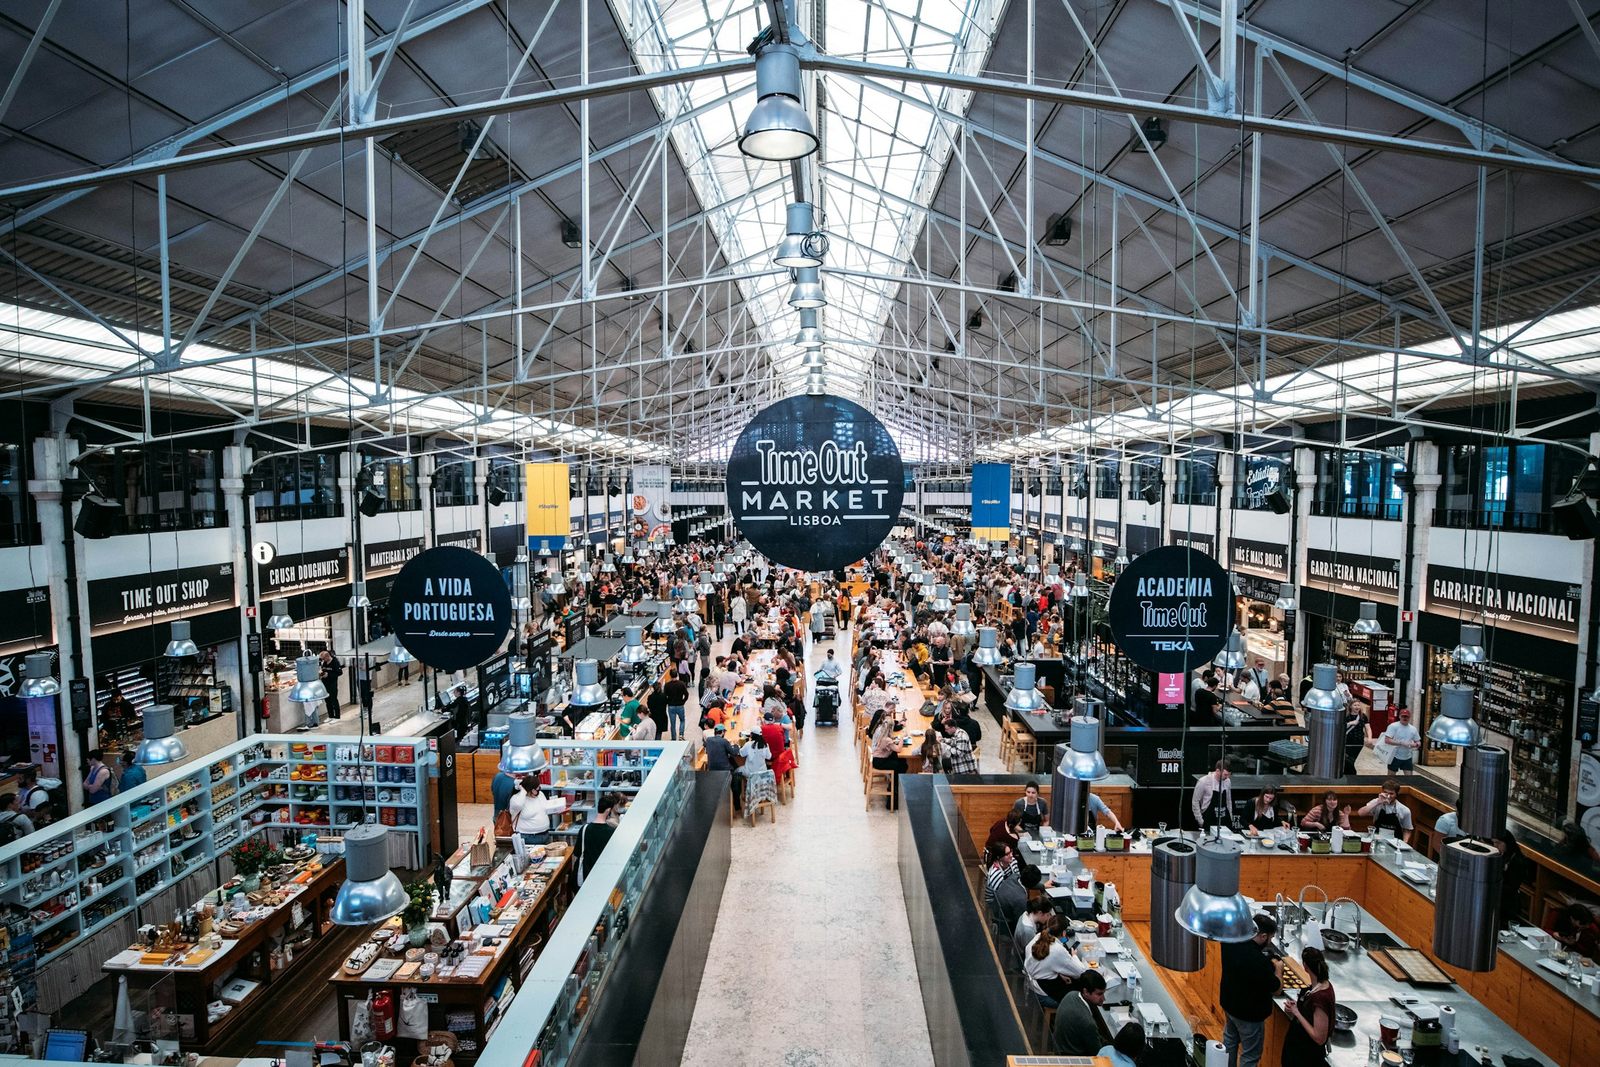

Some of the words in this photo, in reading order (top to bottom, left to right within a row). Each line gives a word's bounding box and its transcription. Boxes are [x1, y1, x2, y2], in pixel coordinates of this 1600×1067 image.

[756, 440, 818, 485] Time
[820, 440, 868, 485] Out
[741, 490, 888, 511] MARKET
[790, 515, 841, 526] LISBOA
[269, 564, 296, 585] CRUSH
[298, 559, 339, 580] DOUGHNUTS
[1356, 566, 1398, 590] NACIONAL
[121, 587, 152, 611] TIME
[156, 583, 178, 605] OUT
[181, 578, 209, 600] SHOP
[425, 578, 433, 596] A
[439, 578, 472, 596] VIDA
[1137, 578, 1212, 597] ACADEMIA
[404, 603, 495, 621] PORTUGUESA
[1140, 601, 1177, 627] Time
[1178, 602, 1207, 627] Out
[1507, 590, 1575, 623] NACIONAL
[429, 630, 448, 638] Desde
[1151, 641, 1194, 651] TEKA
[1161, 762, 1179, 773] BAR
